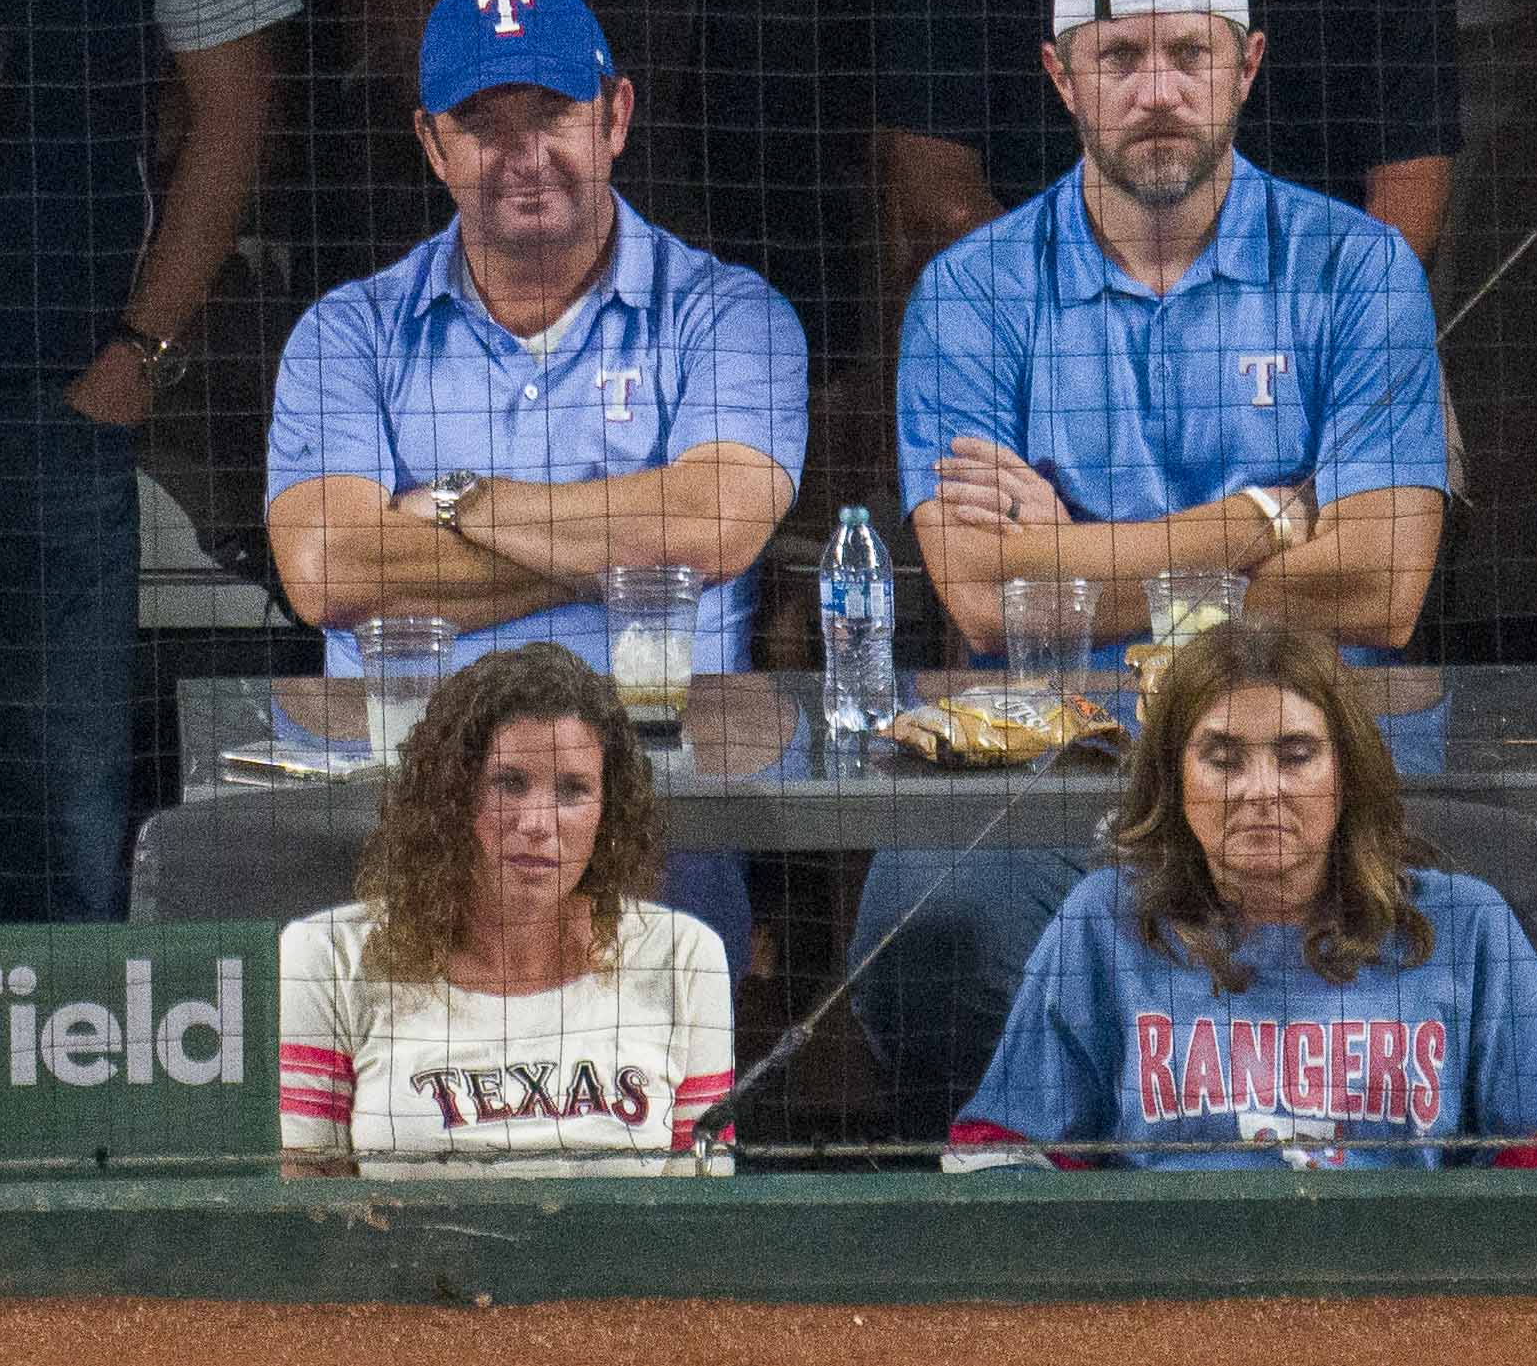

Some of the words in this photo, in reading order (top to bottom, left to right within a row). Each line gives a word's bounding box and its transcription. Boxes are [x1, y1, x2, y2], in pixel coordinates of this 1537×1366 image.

[595, 367, 644, 423] T
[1238, 354, 1288, 408] T
[411, 1060, 650, 1129] TEXAS
[1135, 1011, 1446, 1130] RANGERS
